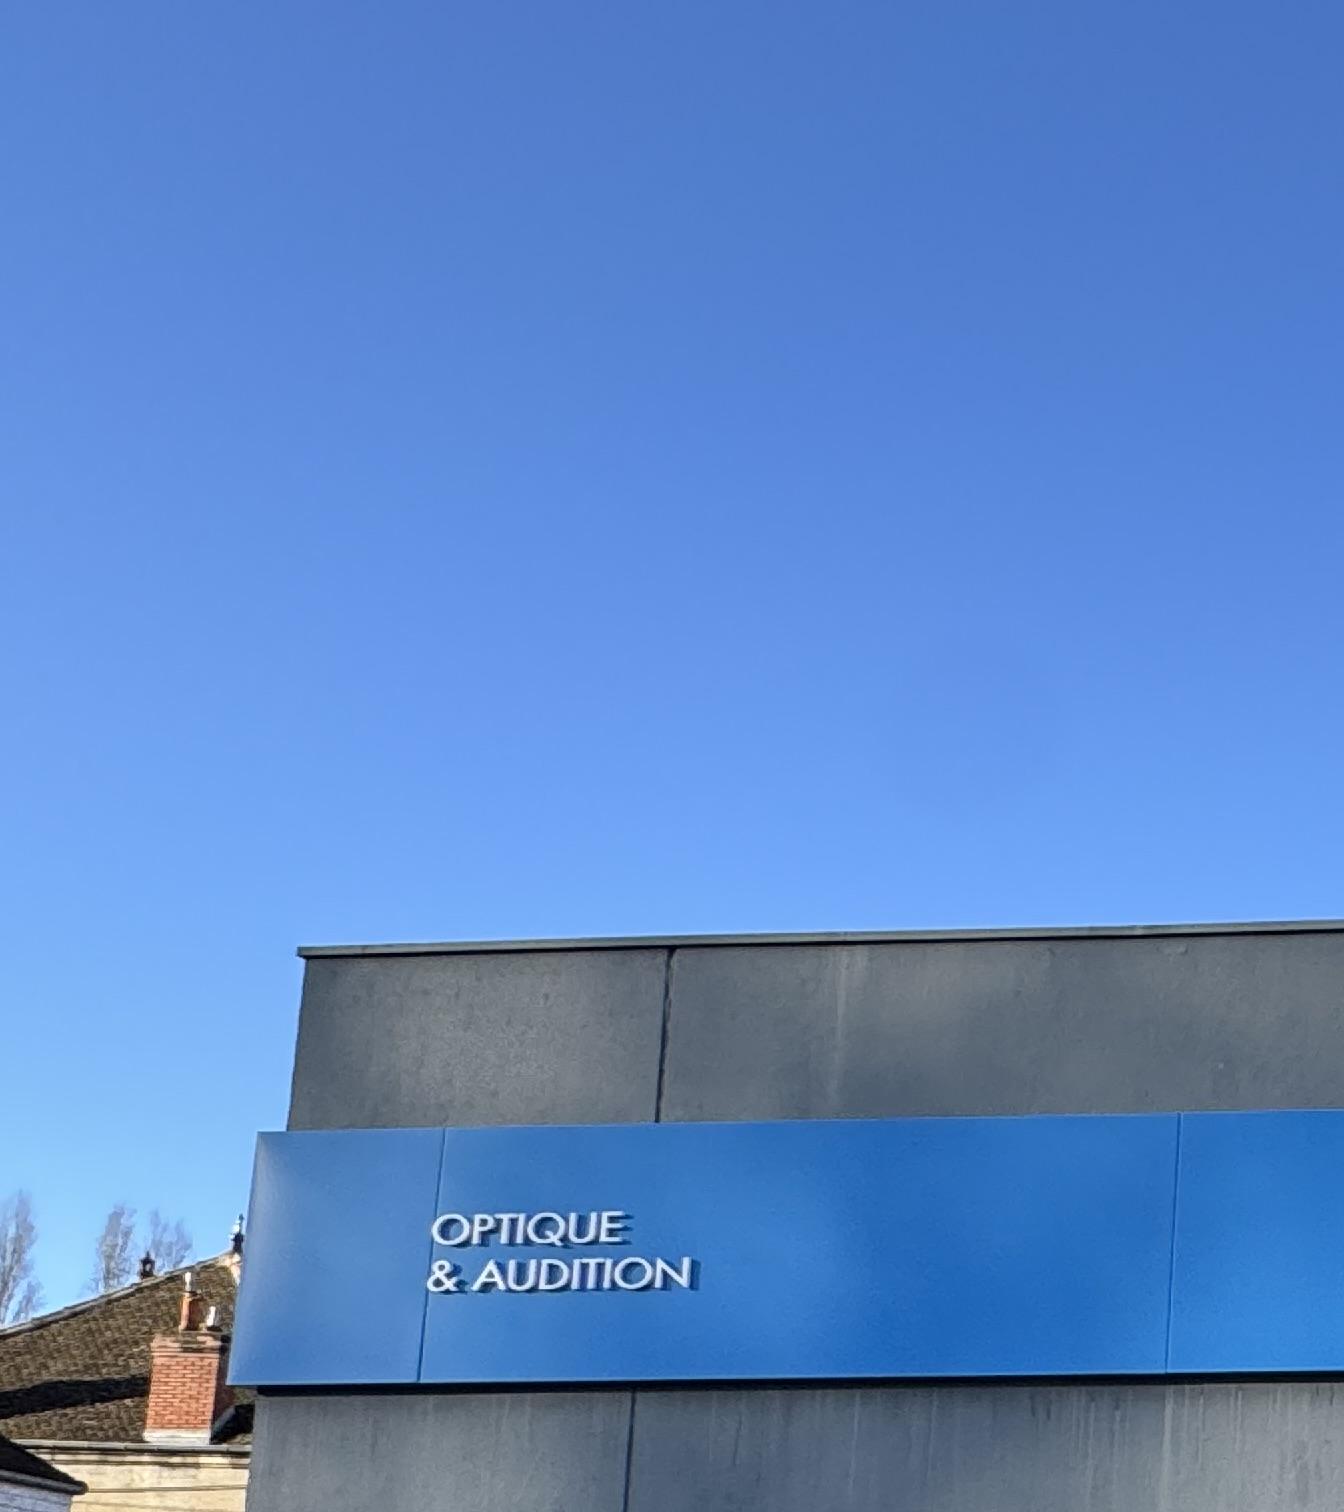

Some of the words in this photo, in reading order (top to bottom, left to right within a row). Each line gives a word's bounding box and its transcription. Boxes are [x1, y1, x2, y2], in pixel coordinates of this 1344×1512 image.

[431, 1210, 625, 1247] OPTIQUE
[426, 1259, 457, 1292] &
[471, 1256, 692, 1291] AUDITION
